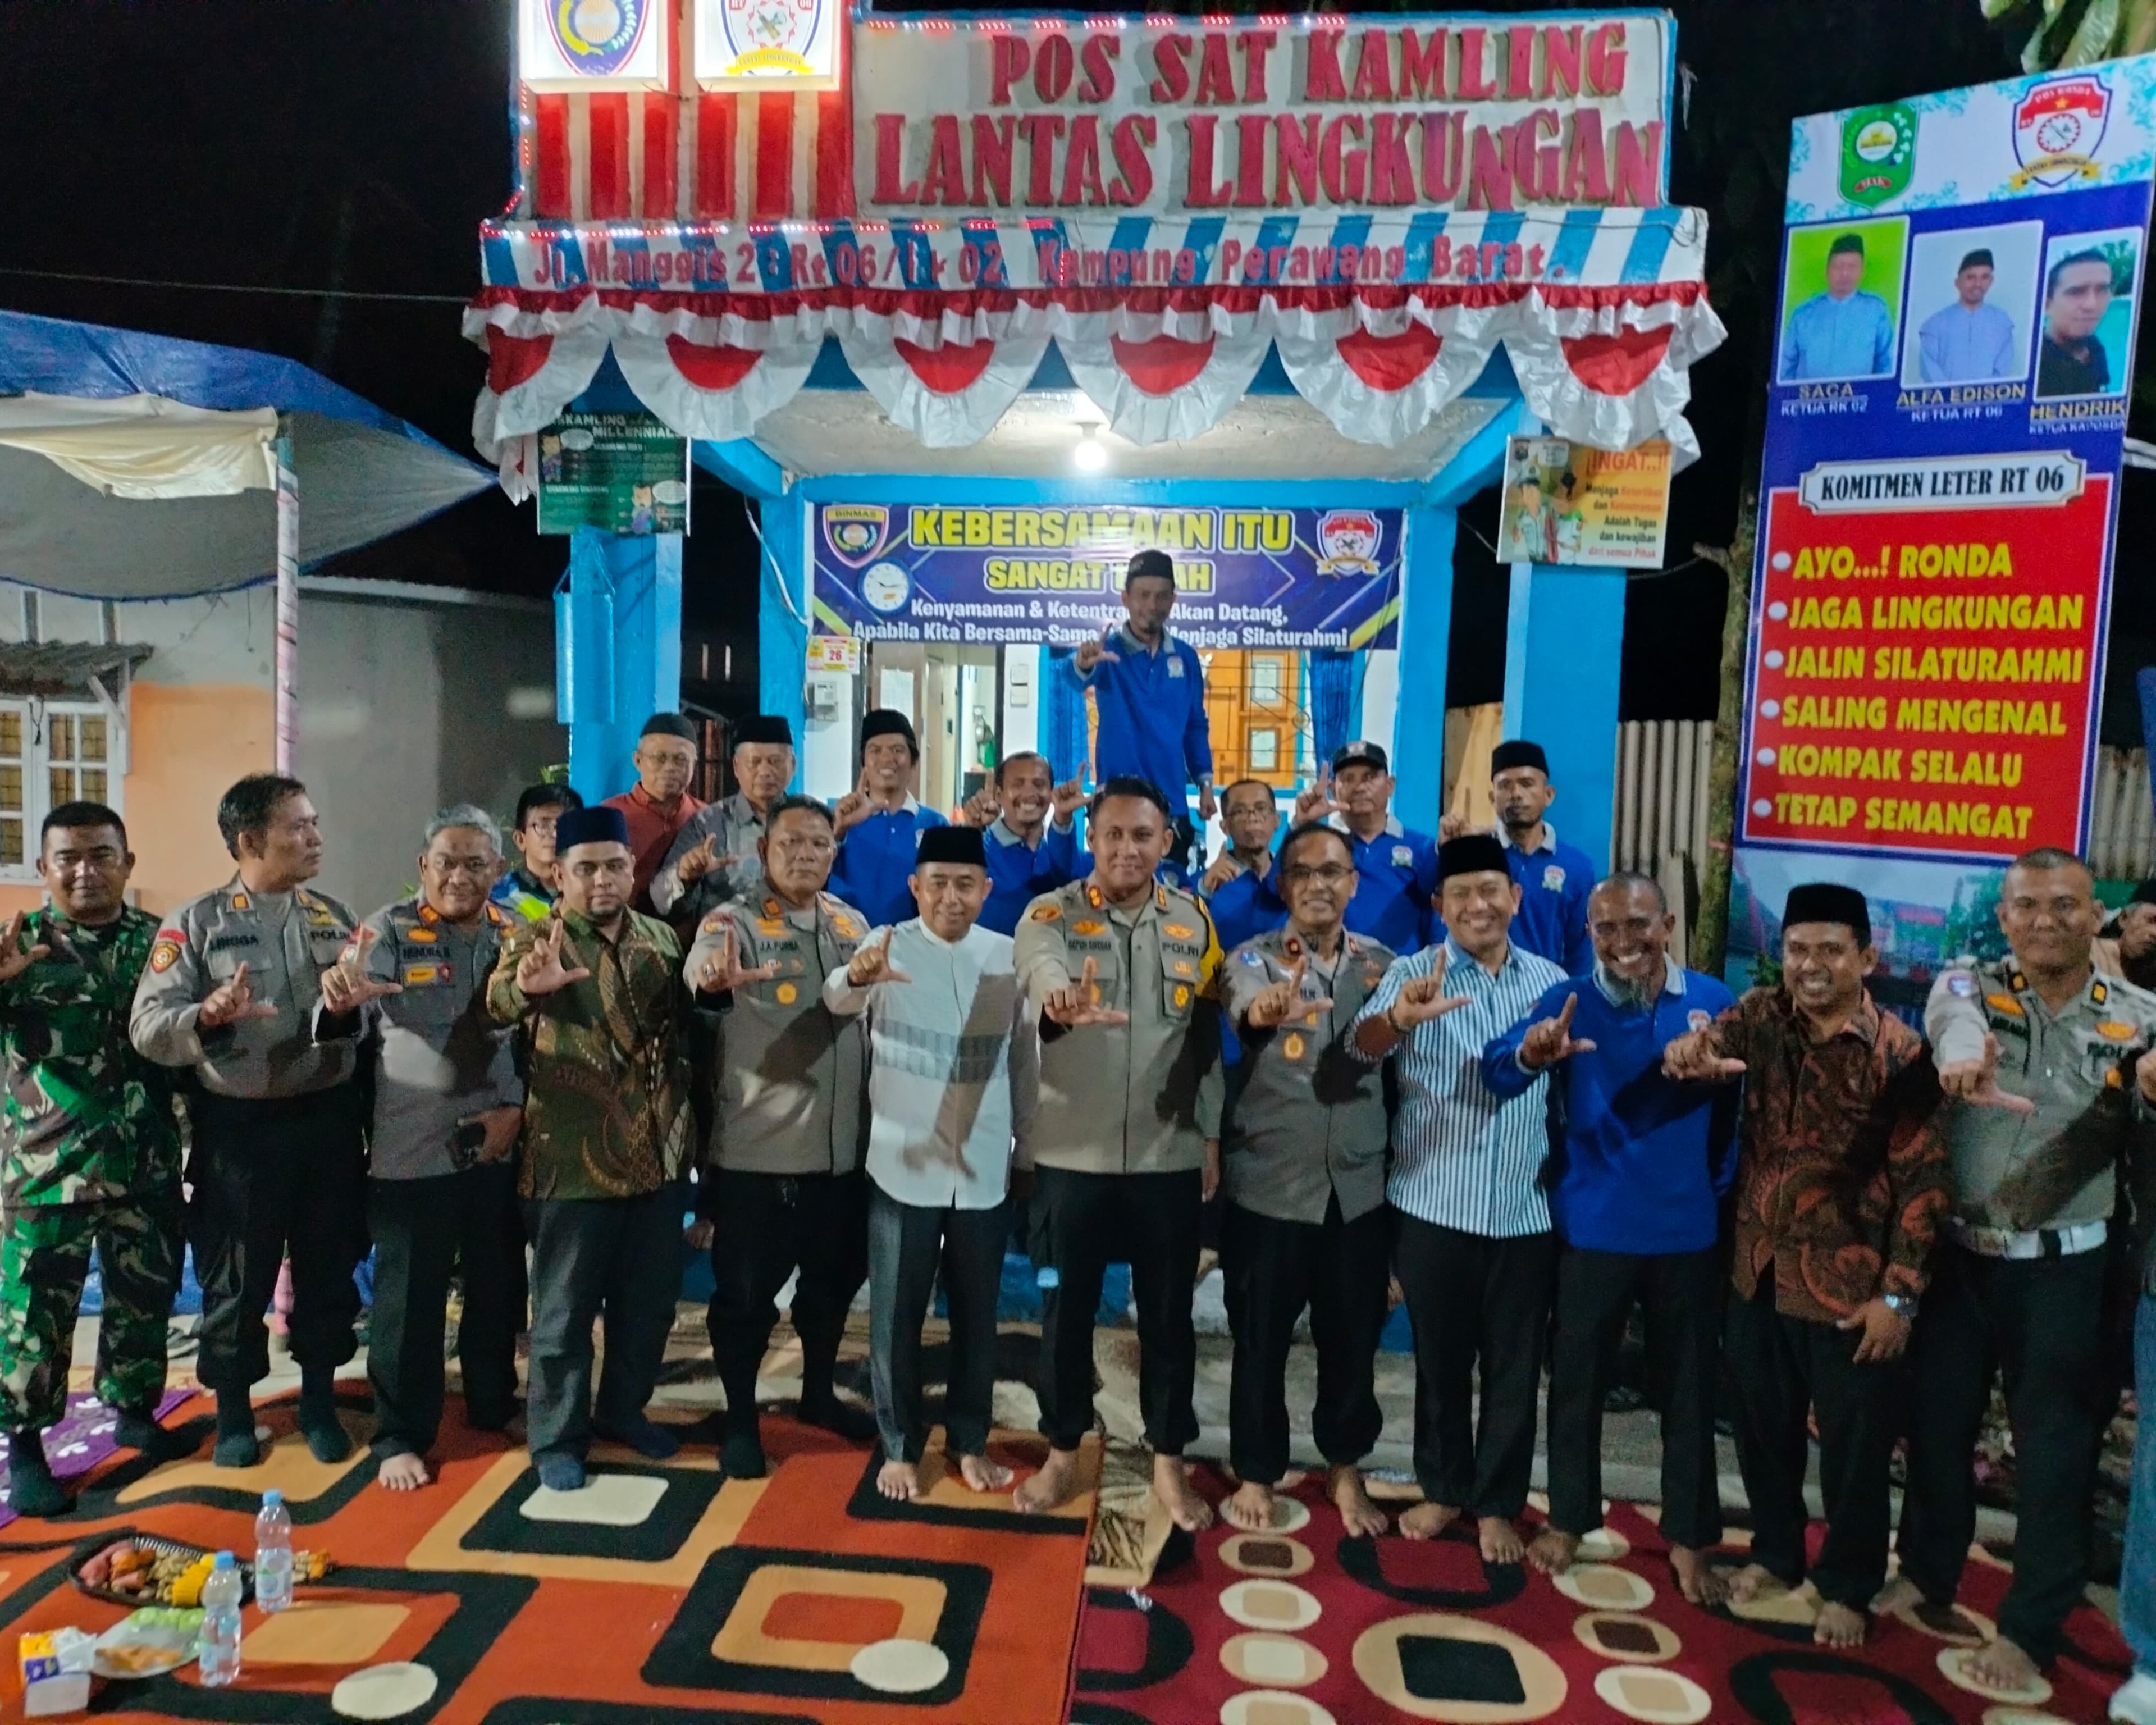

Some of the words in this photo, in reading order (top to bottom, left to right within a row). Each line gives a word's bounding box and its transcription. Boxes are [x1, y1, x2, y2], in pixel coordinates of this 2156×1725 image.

[990, 34, 1120, 105] POS
[1150, 31, 1277, 105] SAT
[1304, 22, 1628, 101] KAMLING
[871, 114, 1157, 207] LANTAS
[1183, 107, 1664, 211] LINGKUNGAN
[587, 241, 728, 282] Manggis
[736, 241, 756, 283] 2
[958, 241, 1003, 282] 02
[1039, 238, 1195, 282] Kampung
[1222, 238, 1404, 281] Perawang
[1432, 235, 1564, 278] Barat.
[1949, 384, 2026, 404] EDISON
[2030, 400, 2125, 419] HENDRIK
[1821, 473, 1925, 501] KOMITMEN
[1930, 468, 1994, 496] LETER
[1999, 467, 2030, 494] RT
[2036, 464, 2064, 492] 06
[912, 509, 1213, 550] KEBERSAMAAN
[1223, 512, 1290, 551] ITU
[987, 559, 1106, 590] SANGAT
[1898, 543, 2013, 579] RONDA
[911, 598, 1025, 621] Kenyamanan
[1029, 601, 1043, 618] &
[1170, 602, 1214, 621] Akan
[1219, 603, 1289, 626] Datang,
[1788, 596, 1864, 629] JAGA
[1872, 594, 2084, 631] LINGKUNGAN
[853, 621, 920, 643] Apabila
[924, 622, 960, 641] Kita
[965, 623, 1098, 642] Bersama-Sama
[1242, 628, 1347, 647] Silaturahmi
[1784, 646, 1865, 679] JALIN
[1874, 647, 2084, 684] SILATURAHMI
[1782, 695, 1887, 731] SALING
[1895, 698, 2067, 736] MENGENAL
[1778, 744, 1903, 781] KOMPAK
[1910, 749, 2022, 787] SELALU
[1775, 793, 1857, 827] TETAP
[1865, 797, 2033, 840] SEMANGAT
[1162, 941, 1199, 956] POLRI
